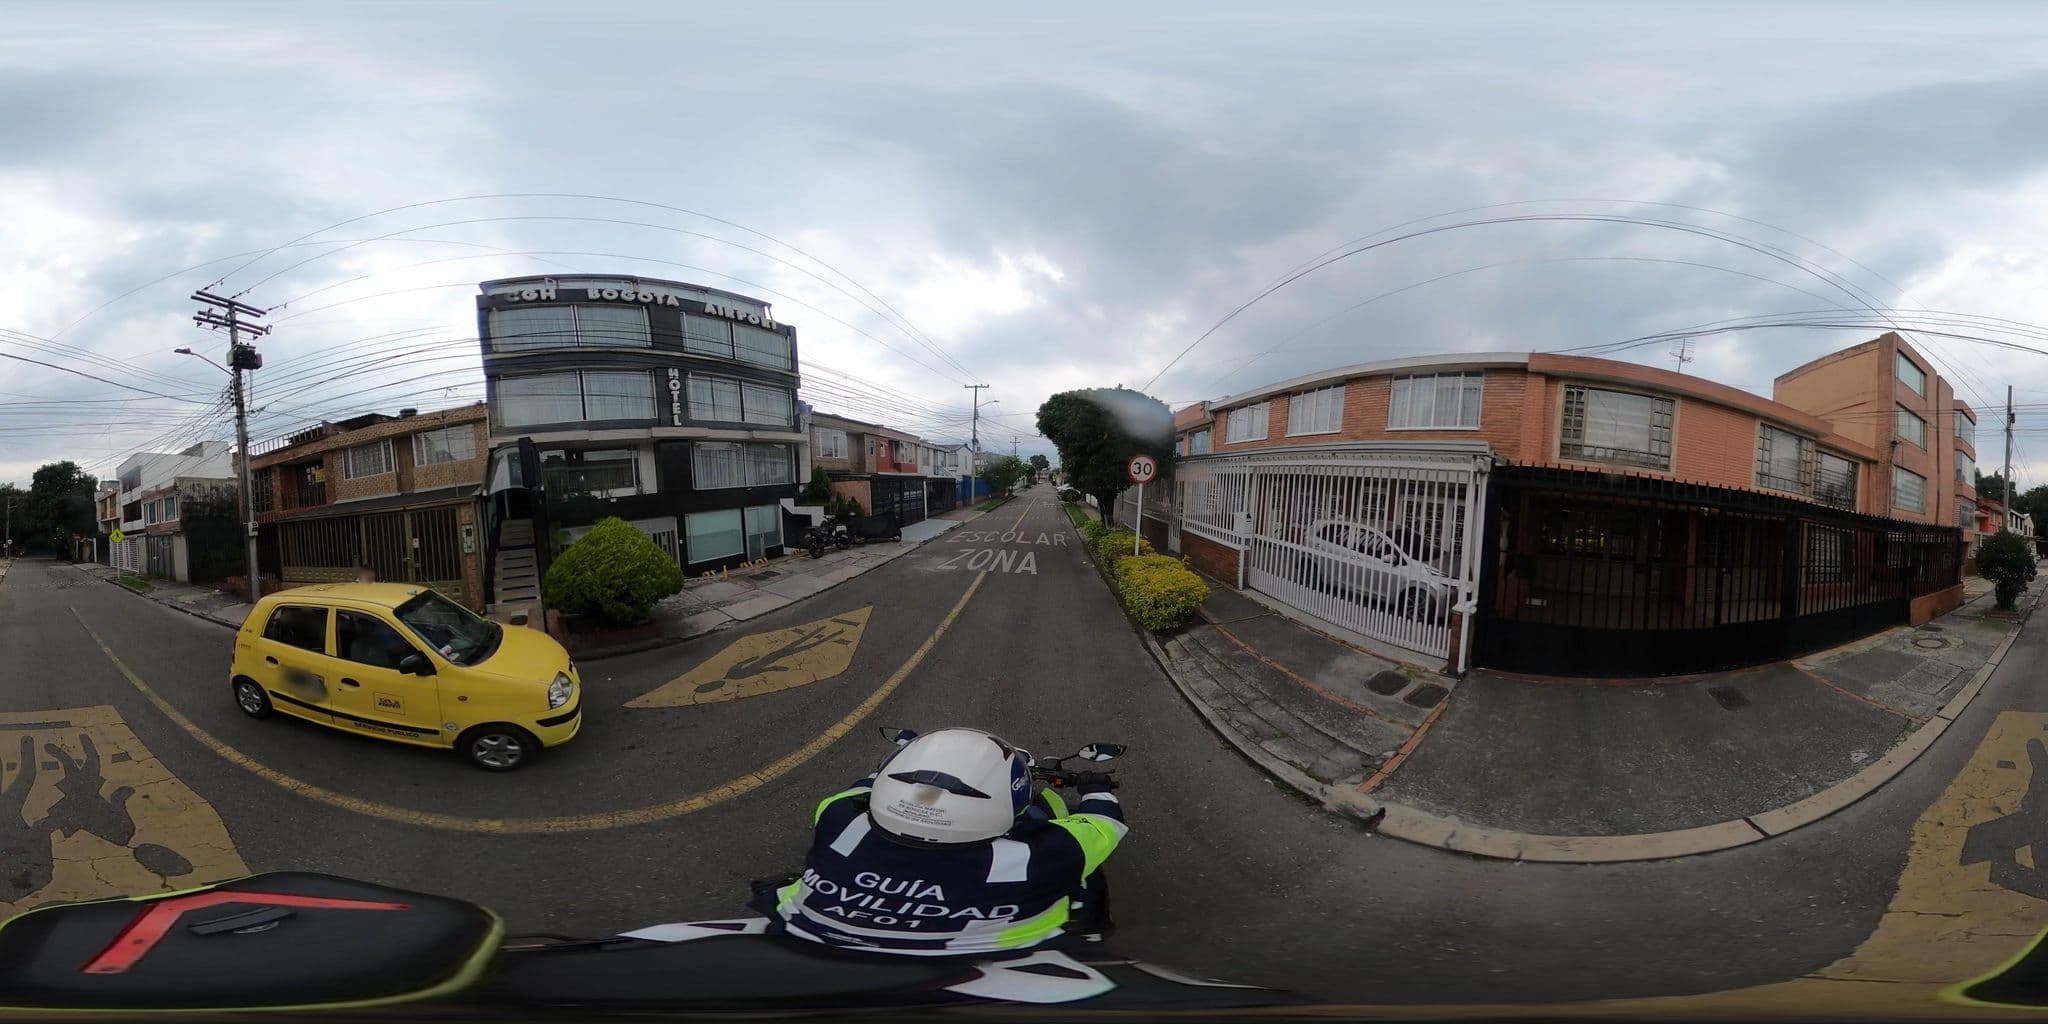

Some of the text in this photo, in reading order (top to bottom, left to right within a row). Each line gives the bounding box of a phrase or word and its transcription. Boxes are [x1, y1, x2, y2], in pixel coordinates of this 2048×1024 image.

[586, 287, 679, 307] BOGOTA
[667, 367, 682, 427] HOTEL
[1132, 462, 1152, 475] 30
[946, 530, 1067, 547] ESCOLAR
[936, 548, 1037, 575] ZONA
[801, 868, 1020, 919] MOVILIDAD
[854, 871, 945, 901] GUÍA
